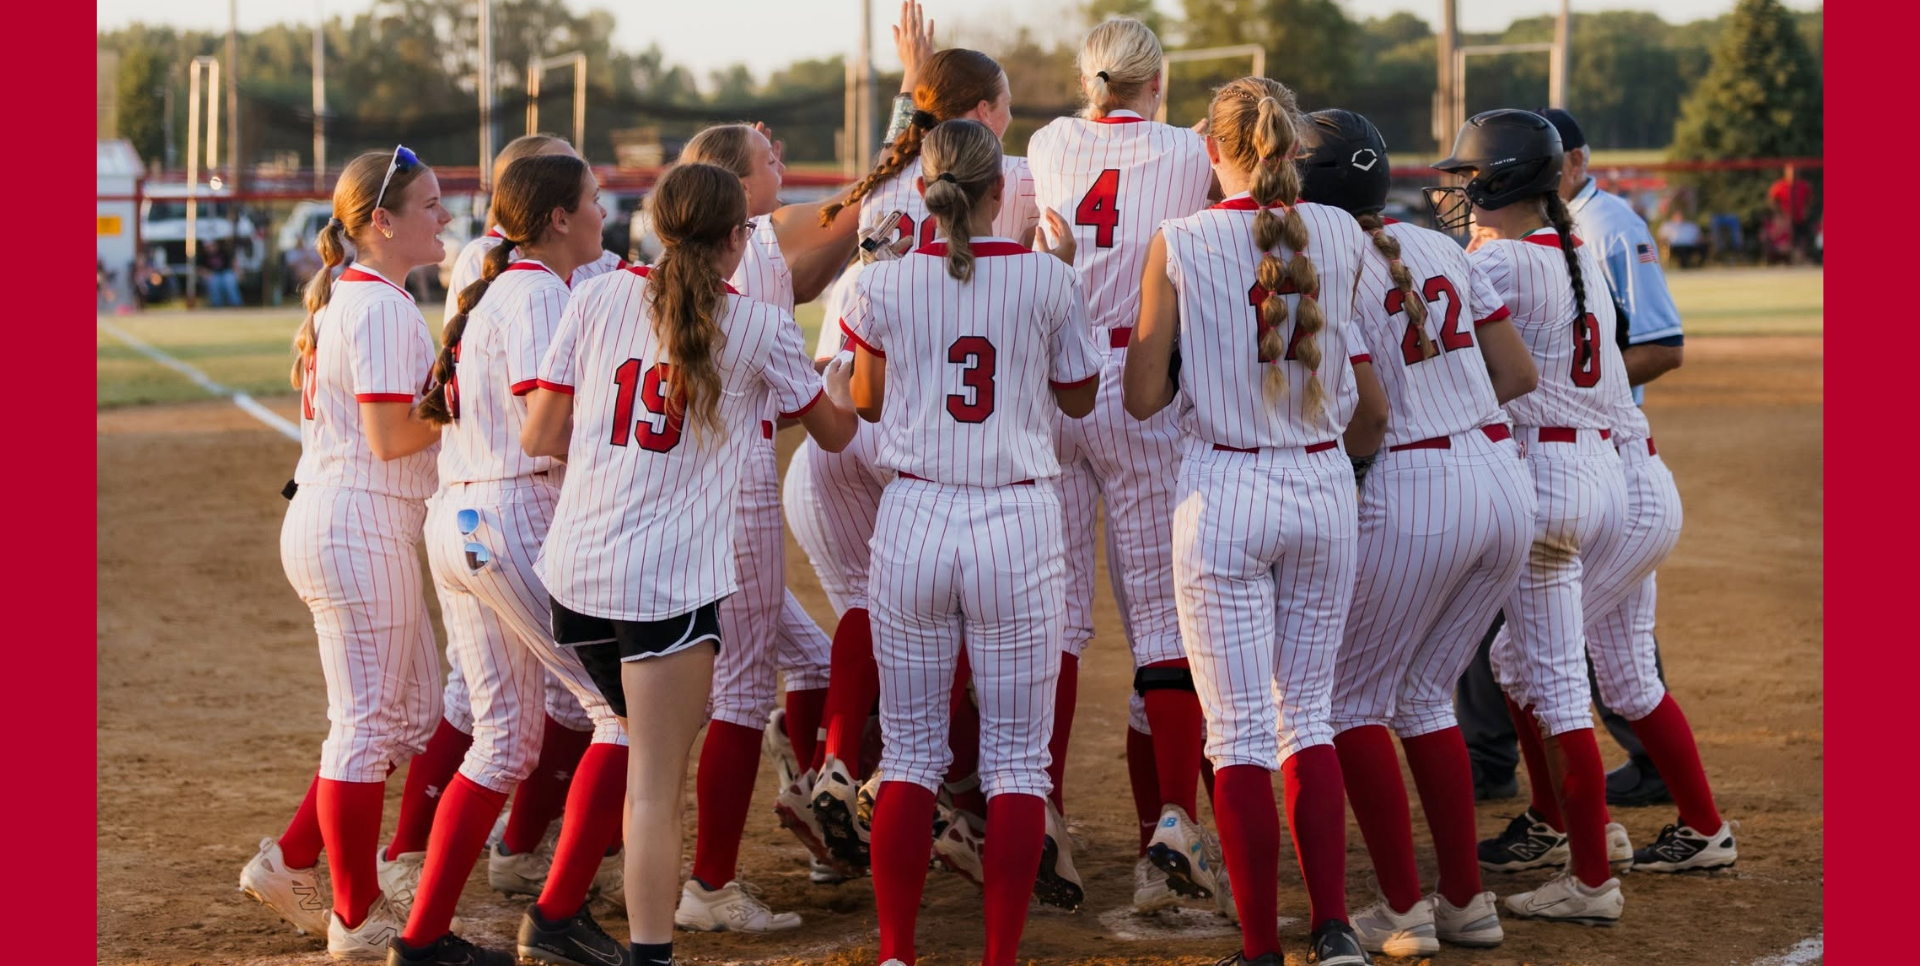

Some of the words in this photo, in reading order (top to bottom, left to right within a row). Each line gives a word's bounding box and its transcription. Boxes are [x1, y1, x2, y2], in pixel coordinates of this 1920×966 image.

[1075, 169, 1120, 248] 4
[1384, 275, 1474, 366] 22
[1570, 312, 1602, 387] 8
[610, 358, 687, 453] 19
[947, 336, 996, 424] 3
